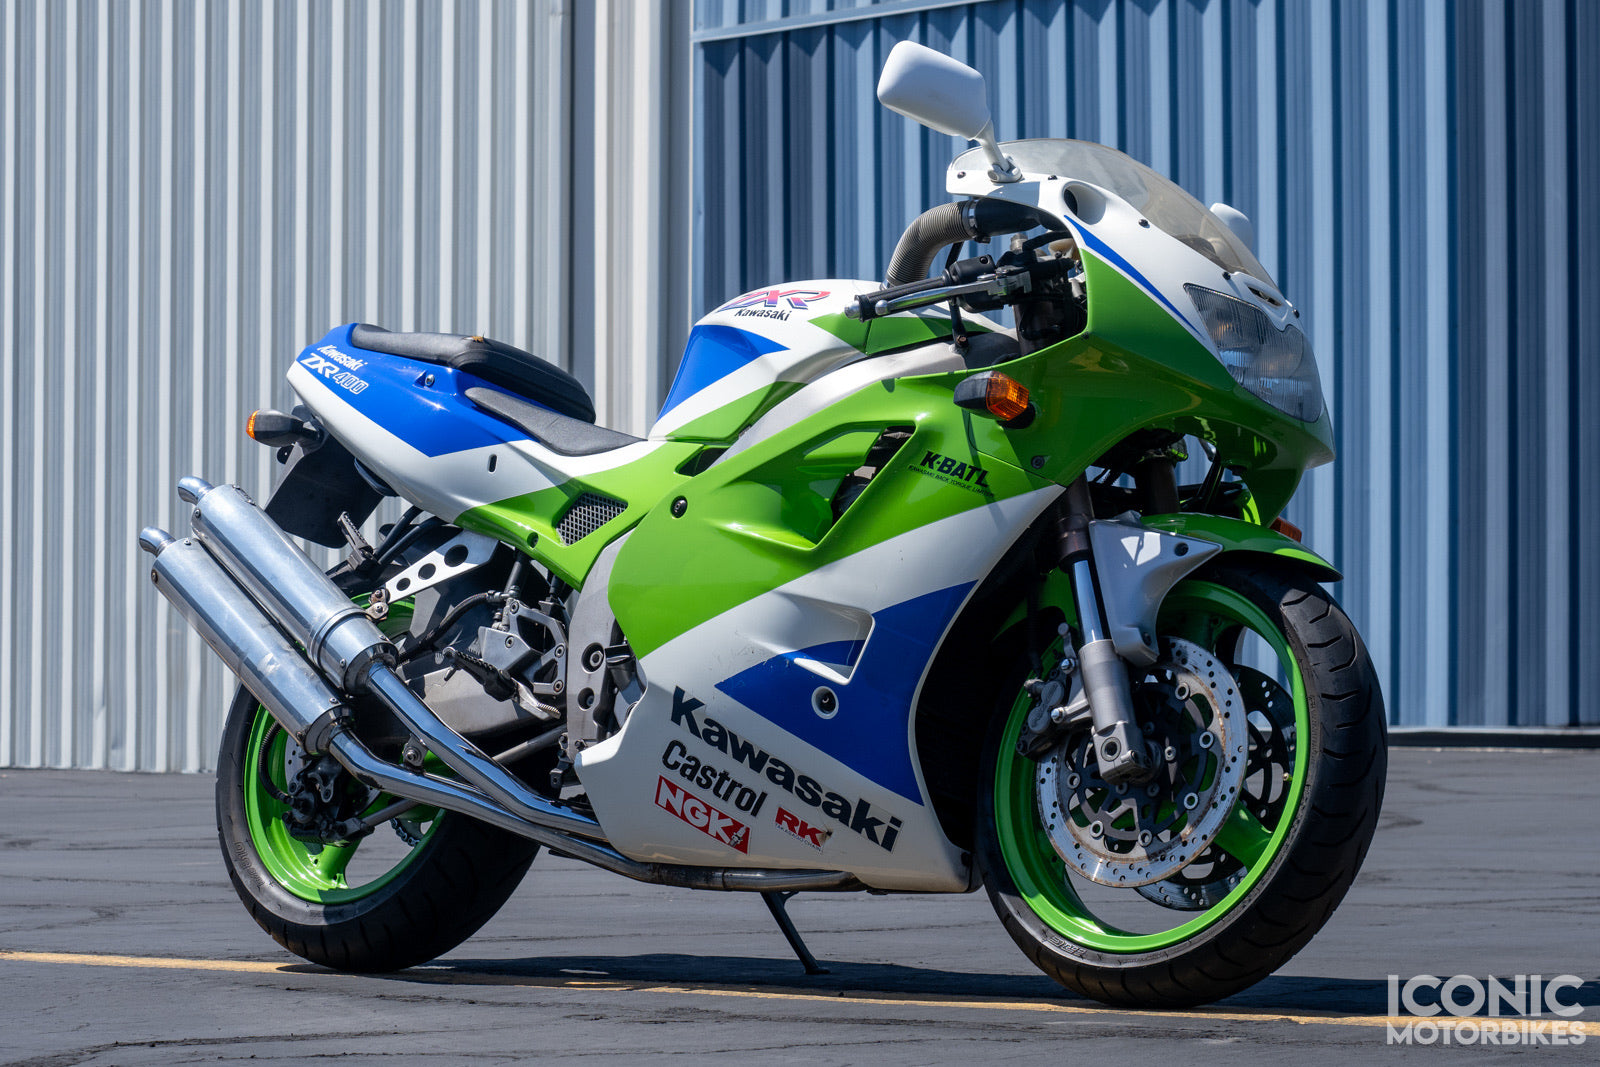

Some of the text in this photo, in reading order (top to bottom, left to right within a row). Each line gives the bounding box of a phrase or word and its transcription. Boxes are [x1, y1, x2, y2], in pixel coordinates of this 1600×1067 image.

[734, 308, 793, 321] Kawasaki
[317, 344, 369, 371] Kawasaki
[662, 740, 768, 817] Castrol
[671, 685, 903, 853] Kawasaki
[657, 779, 732, 845] NGK
[775, 806, 826, 848] RK
